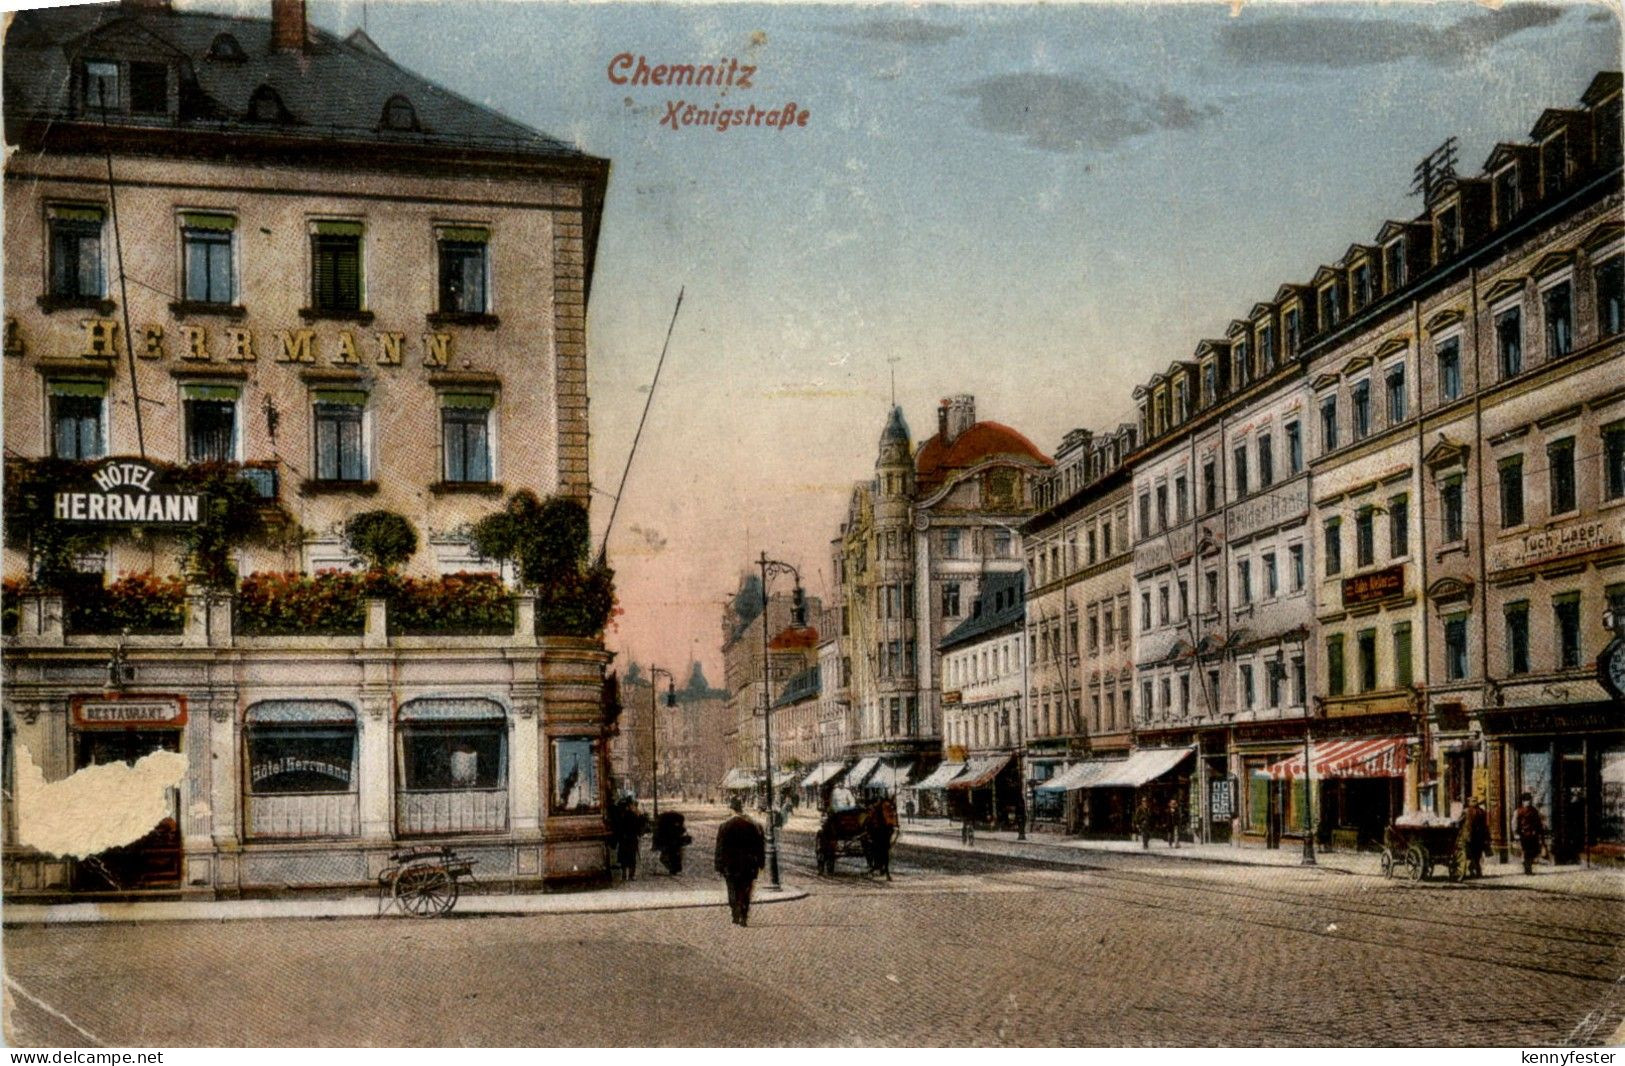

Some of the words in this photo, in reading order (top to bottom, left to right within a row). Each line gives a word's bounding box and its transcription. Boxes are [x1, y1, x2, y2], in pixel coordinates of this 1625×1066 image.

[92, 461, 155, 492] HÔTEL
[54, 493, 198, 521] HERRMANN
[1521, 530, 1553, 554] Tuch
[1561, 523, 1603, 543] Lager
[287, 757, 348, 781] Herrmann
